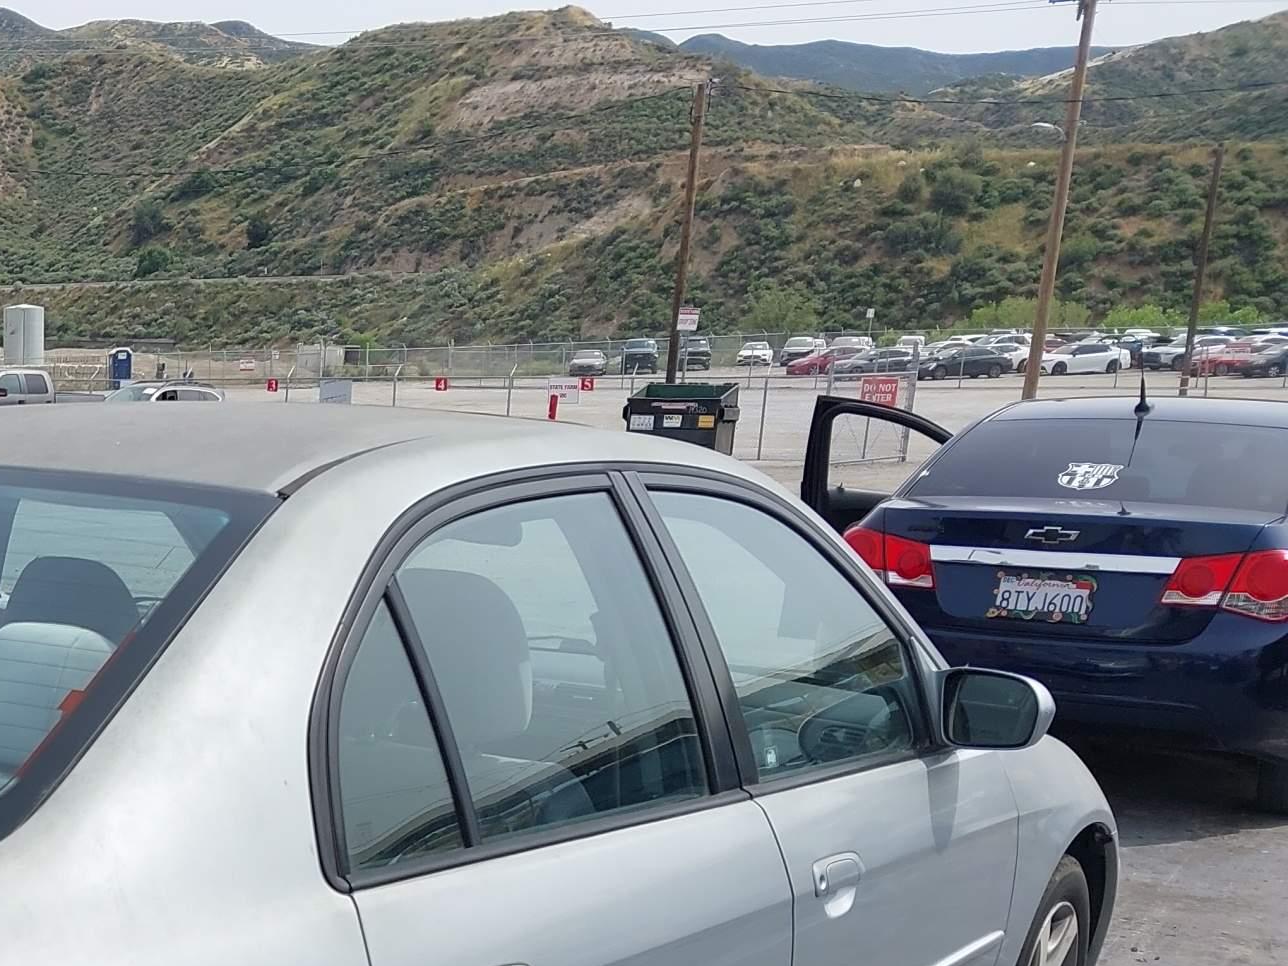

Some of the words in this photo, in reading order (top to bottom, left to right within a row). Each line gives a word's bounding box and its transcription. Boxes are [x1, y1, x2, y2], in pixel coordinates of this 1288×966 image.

[863, 383, 876, 393] DO
[878, 383, 896, 392] NOT
[865, 393, 893, 402] ENTER
[1018, 578, 1071, 590] California
[1000, 589, 1084, 613] 8TYJ600
